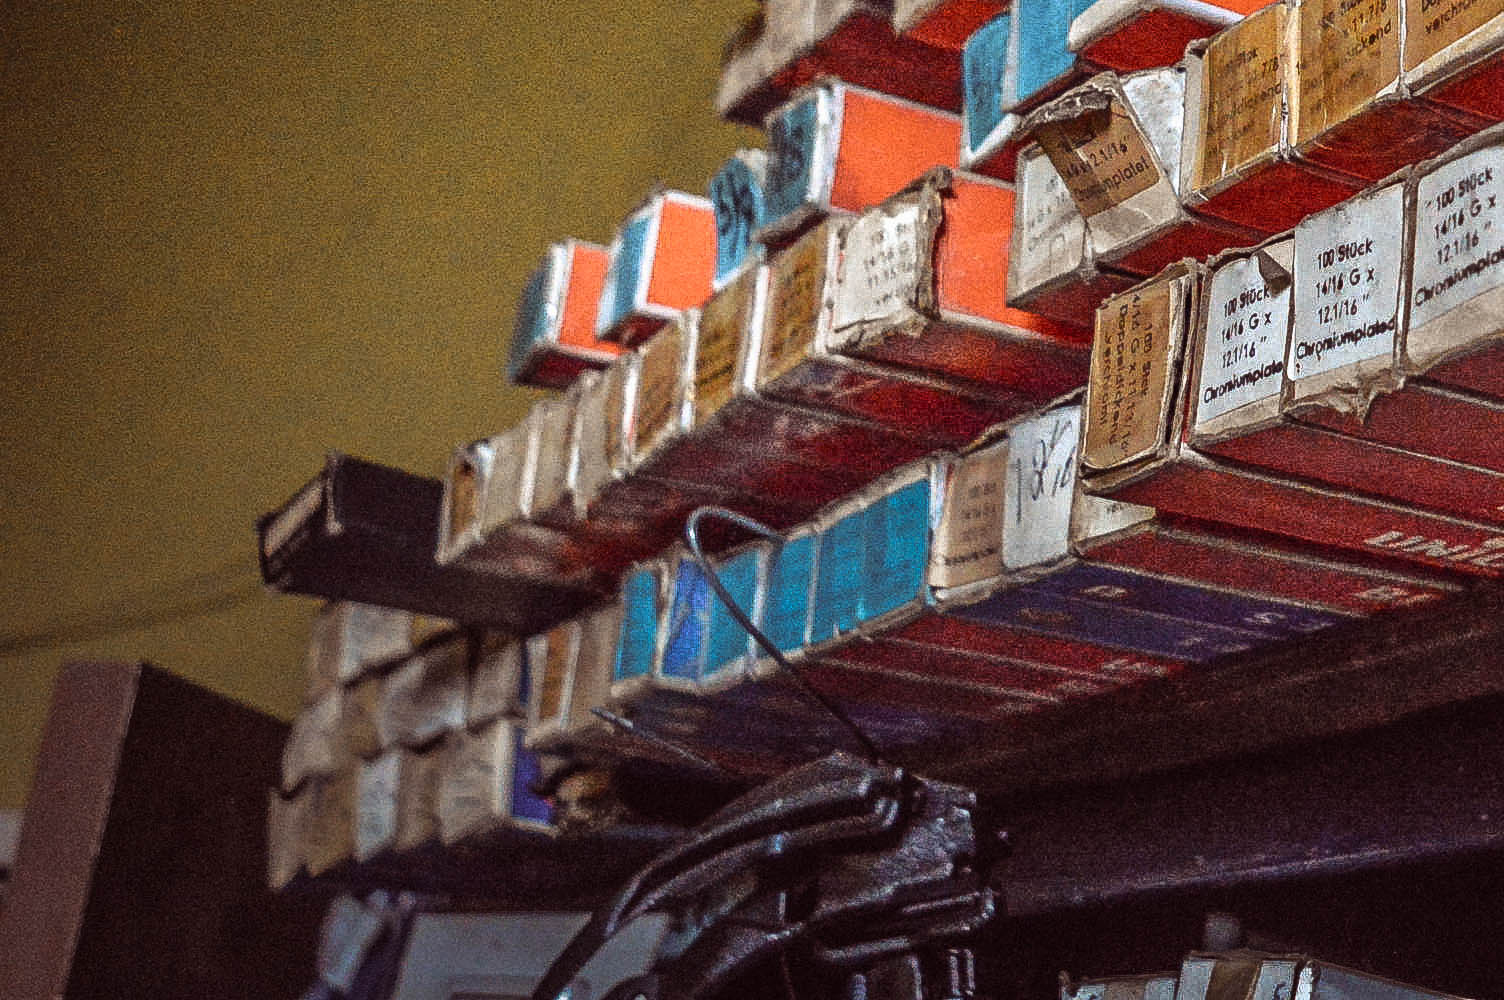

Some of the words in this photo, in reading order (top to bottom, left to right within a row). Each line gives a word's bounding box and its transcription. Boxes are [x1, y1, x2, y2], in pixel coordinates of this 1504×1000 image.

[1436, 186, 1456, 212] 100
[1469, 199, 1482, 218] G
[1487, 194, 1497, 209] x
[1317, 248, 1336, 271] 100
[1337, 237, 1374, 263] Stück
[1315, 271, 1344, 299] 14/16
[1349, 267, 1361, 287] G
[1366, 267, 1376, 283] x
[1223, 296, 1239, 318] 100
[1239, 284, 1271, 309] Stück
[1221, 318, 1244, 345] 14/16
[1248, 312, 1260, 331] G
[1263, 311, 1272, 326] x
